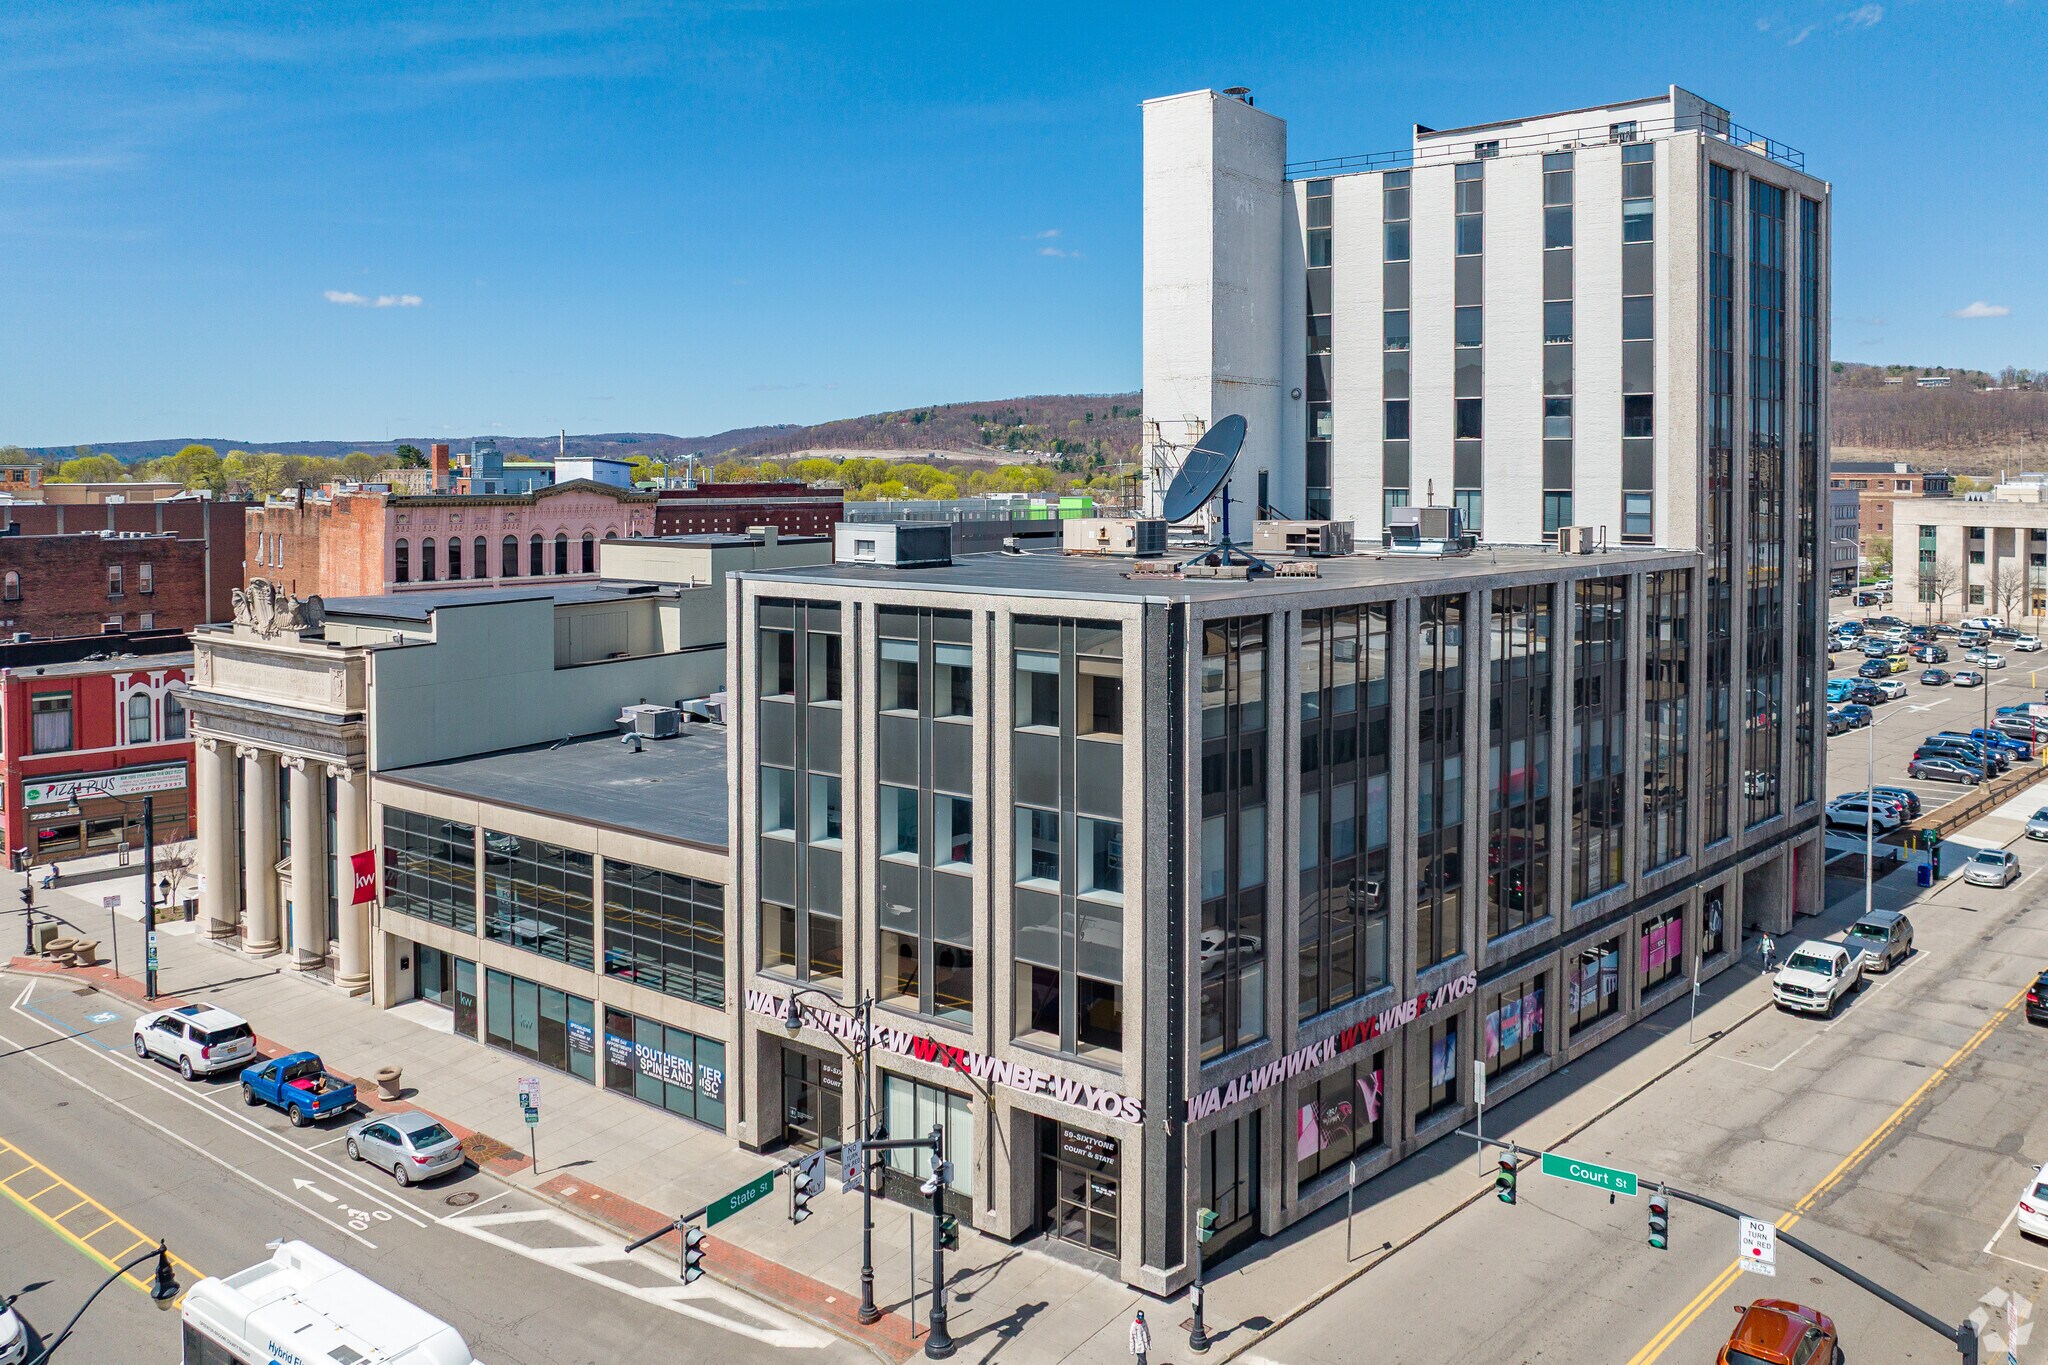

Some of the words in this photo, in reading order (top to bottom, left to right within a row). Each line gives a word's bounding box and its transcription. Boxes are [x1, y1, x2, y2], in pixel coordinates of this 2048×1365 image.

[87, 777, 116, 793] PLUS
[355, 873, 376, 889] kw
[460, 991, 472, 1007] kw
[635, 1043, 693, 1074] SOUTHERN
[640, 1058, 670, 1078] SPINE
[671, 1068, 693, 1085] AND
[1063, 1130, 1115, 1151] 59-SIXTYONE
[846, 1153, 859, 1161] TURN
[847, 1145, 857, 1155] NO
[1063, 1144, 1087, 1156] COURT
[1087, 1151, 1094, 1159] &
[1094, 1153, 1115, 1165] STATE
[843, 1163, 851, 1171] ON
[851, 1158, 861, 1167] RED
[1569, 1164, 1609, 1184] Court
[1615, 1178, 1628, 1188] St
[730, 1188, 756, 1209] State
[759, 1182, 768, 1193] St
[1750, 1222, 1765, 1231] NO
[1748, 1231, 1768, 1241] TURN
[1757, 1241, 1772, 1250] RED
[268, 1340, 293, 1363] Hybrid
